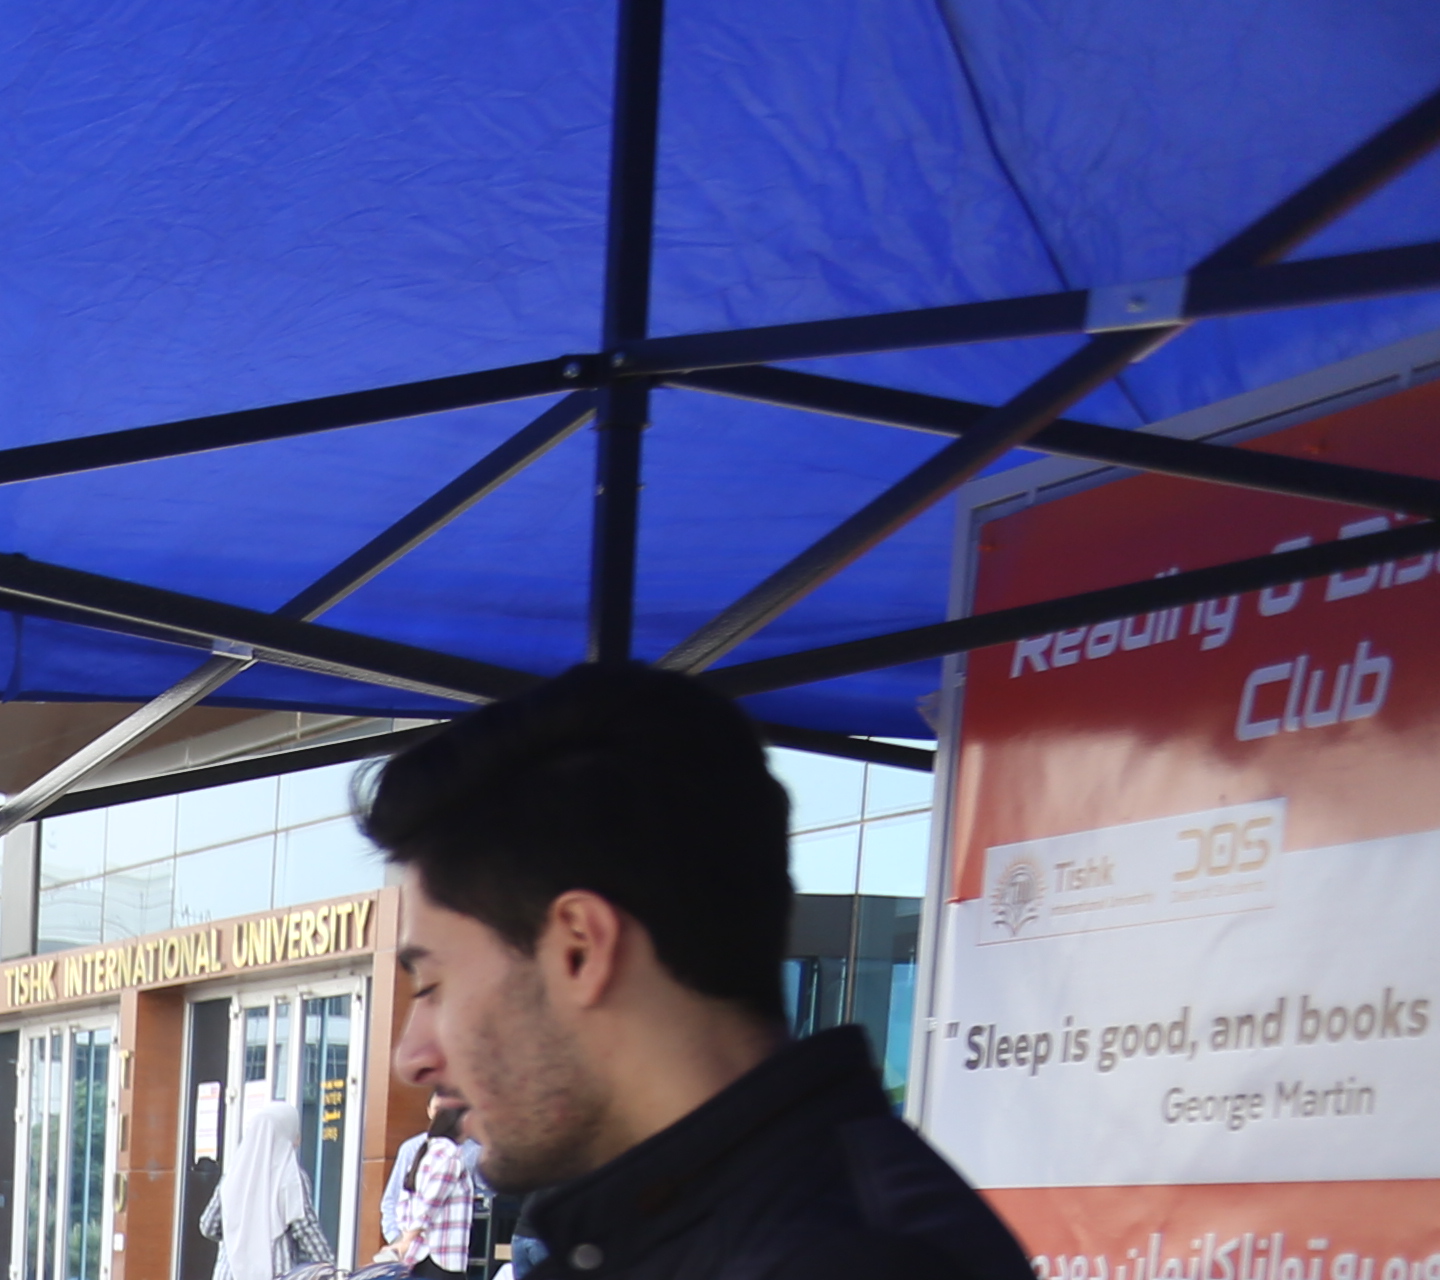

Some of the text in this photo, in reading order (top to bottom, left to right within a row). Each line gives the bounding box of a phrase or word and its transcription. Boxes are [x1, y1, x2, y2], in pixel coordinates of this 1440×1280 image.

[1236, 640, 1395, 742] Club
[1053, 857, 1116, 893] Tishk
[3, 898, 374, 1009] TISHK INTERNATIONAL UNIVERSITY
[1060, 1015, 1090, 1064] is
[1096, 1005, 1199, 1073] good,
[1208, 997, 1287, 1051] and
[1296, 987, 1431, 1042] books
[1161, 1076, 1376, 1131] George Martin
